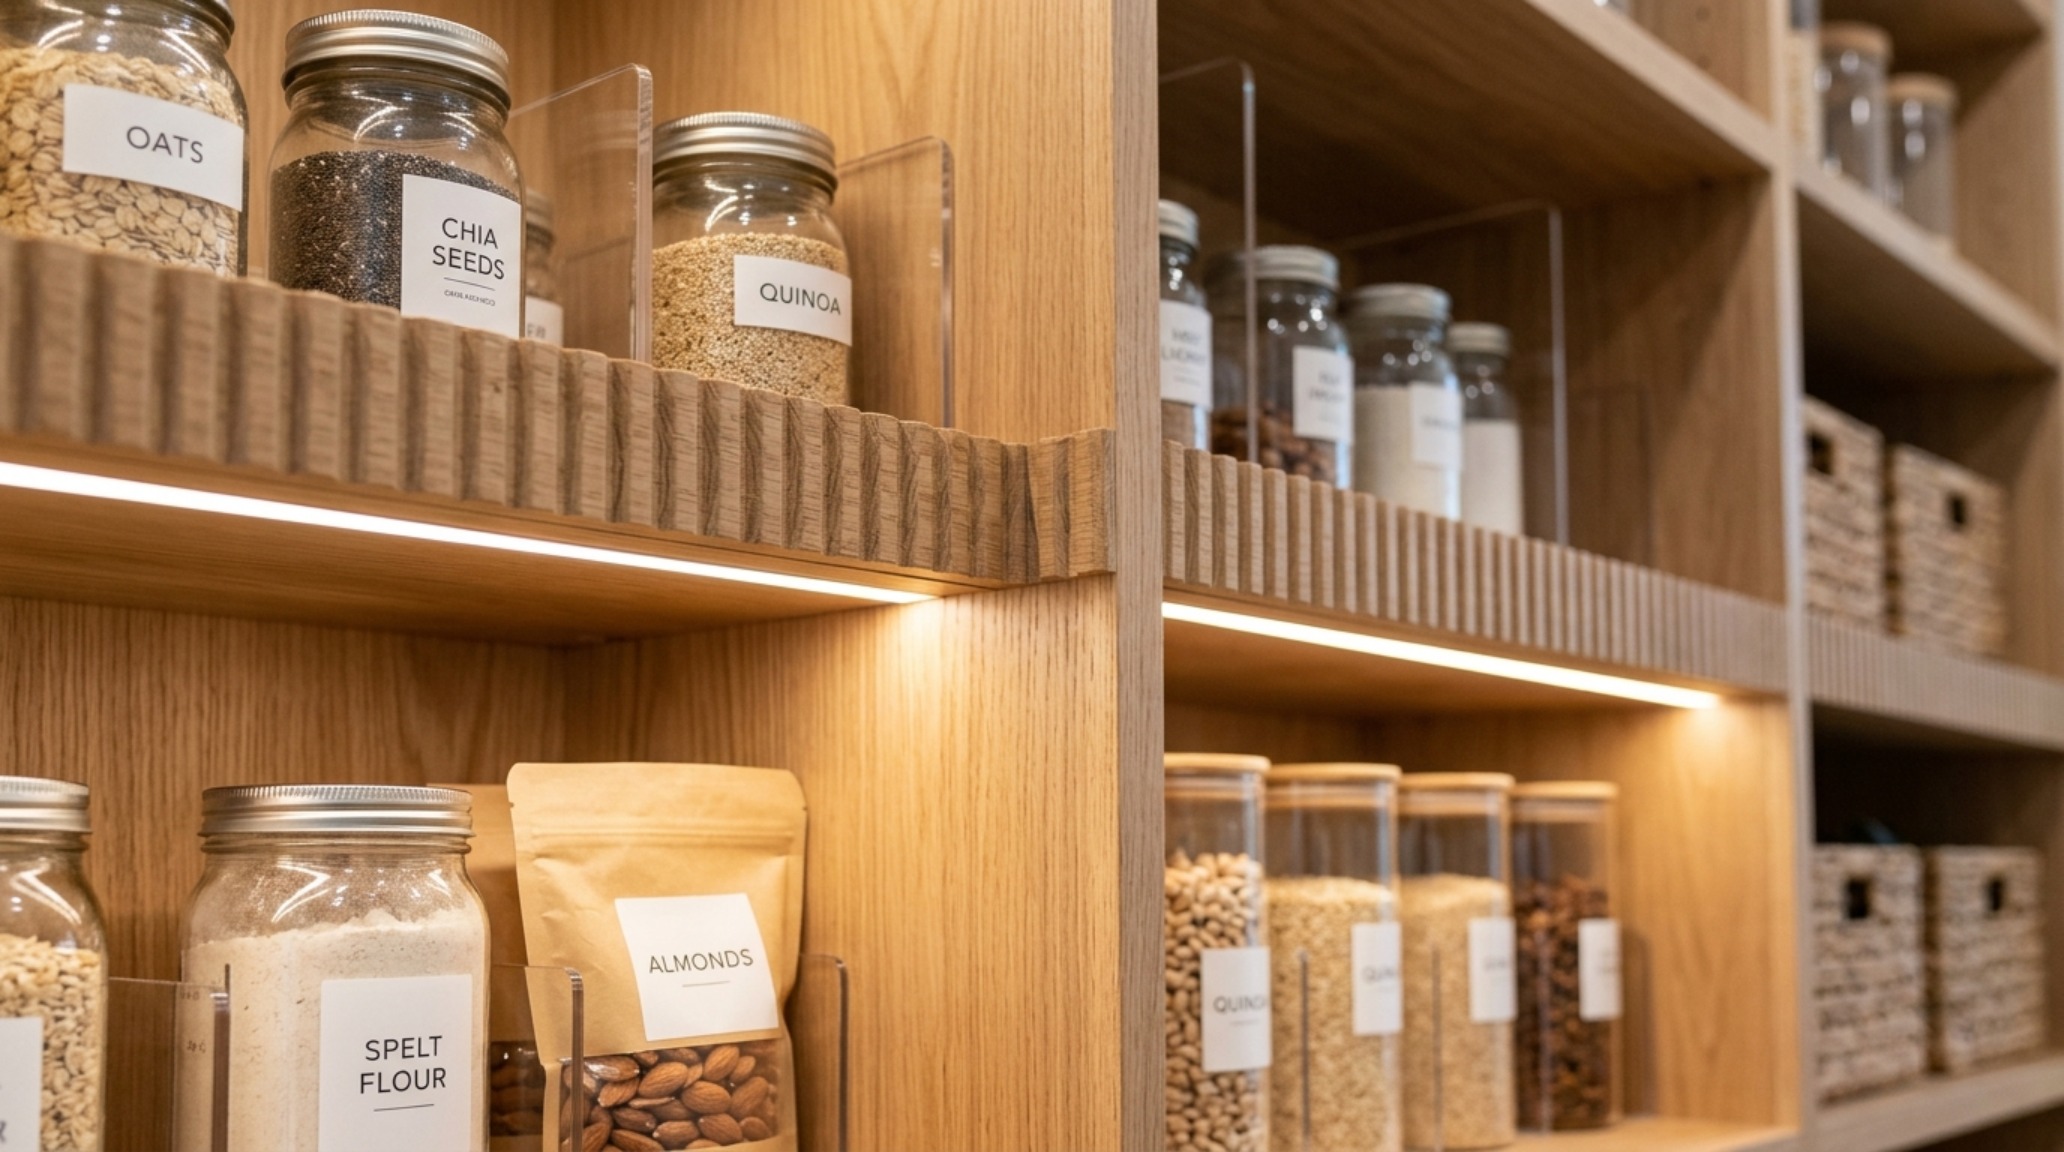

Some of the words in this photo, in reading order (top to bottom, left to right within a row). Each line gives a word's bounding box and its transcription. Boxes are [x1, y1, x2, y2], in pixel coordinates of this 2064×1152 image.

[126, 126, 204, 164] OATS
[442, 217, 499, 250] CHIA
[432, 245, 505, 280] SEEDS
[760, 282, 841, 315] QUINOA
[649, 948, 754, 974] ALMONDS
[365, 1035, 442, 1061] SPELT
[360, 1067, 446, 1094] FLOUR
